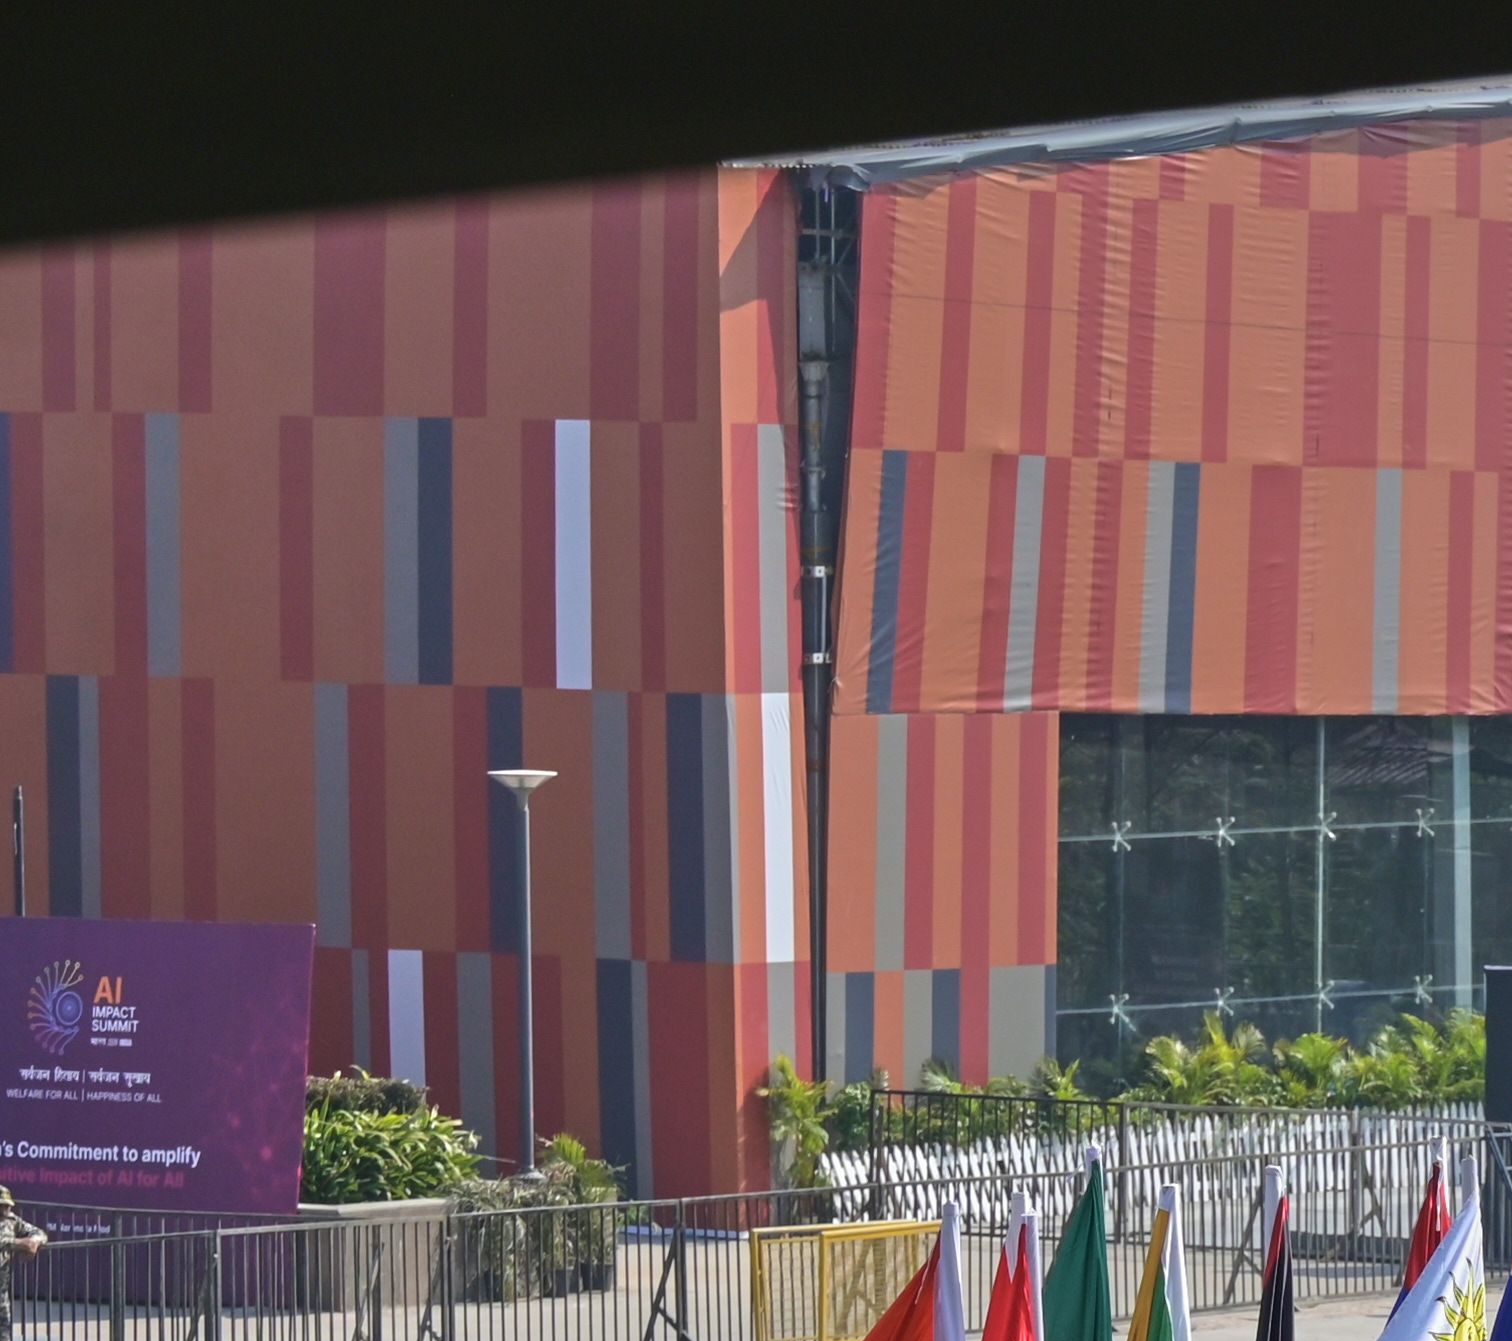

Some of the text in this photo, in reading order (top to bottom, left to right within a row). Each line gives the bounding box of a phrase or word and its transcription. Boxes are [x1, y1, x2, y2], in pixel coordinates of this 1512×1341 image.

[93, 976, 124, 1004] AI
[92, 1005, 137, 1020] IMPACT
[91, 1019, 140, 1033] SUMMIT
[6, 1088, 162, 1103] WELFARE FOR ALL HAPPINESS OF ALL
[17, 1141, 119, 1162] Commitment
[123, 1145, 139, 1162] to
[141, 1145, 202, 1168] amplify
[39, 1167, 95, 1186] Impact
[97, 1169, 115, 1186] of
[116, 1170, 133, 1187] AI
[137, 1170, 160, 1188] for
